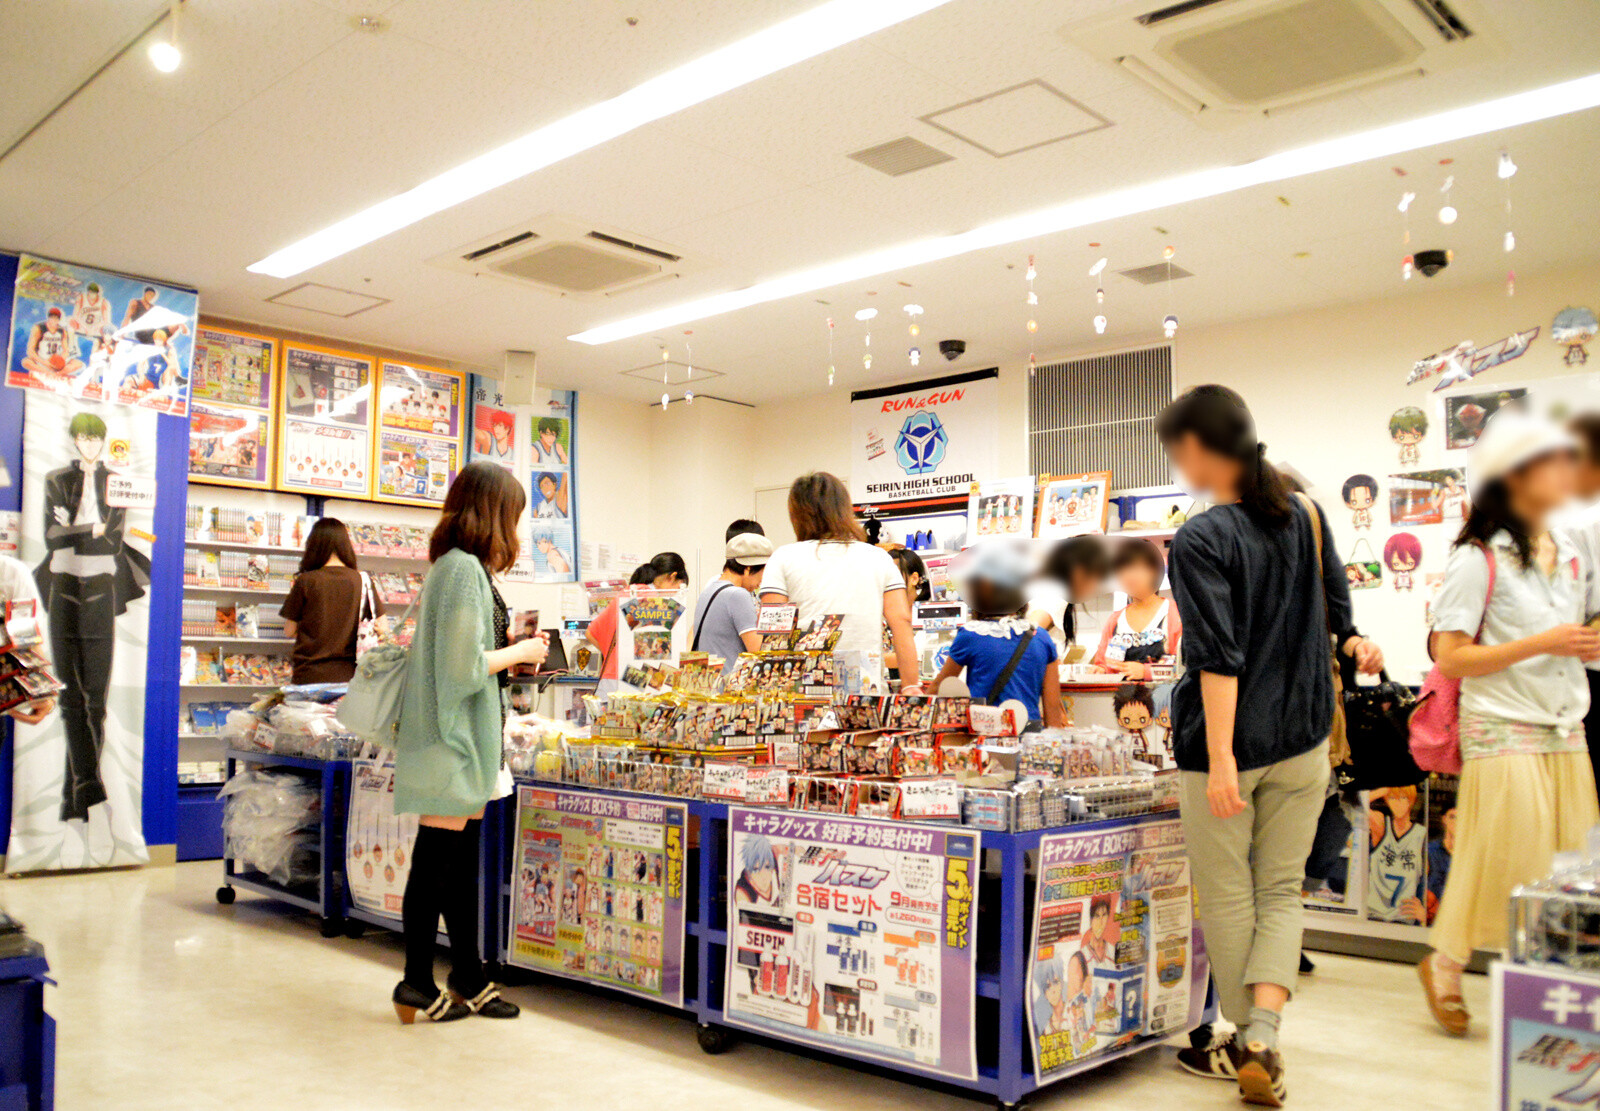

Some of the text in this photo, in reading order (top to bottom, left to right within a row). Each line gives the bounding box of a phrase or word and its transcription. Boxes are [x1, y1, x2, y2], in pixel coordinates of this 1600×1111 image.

[881, 388, 966, 413] RUN&GUN
[866, 473, 976, 494] SEIRIN HIGH SCHOOL
[888, 485, 957, 499] BASKETBALL CLUB
[634, 610, 673, 620] SAMPLE
[557, 797, 591, 813] キャラグッズ
[744, 815, 934, 852] キャラグッズ 好評予約受付中!
[1044, 835, 1103, 862] キャラグッズ
[812, 858, 890, 890] バスケ
[796, 883, 883, 917] 合宿セット
[890, 891, 939, 912] 9月発売予定
[1384, 873, 1405, 908] 7
